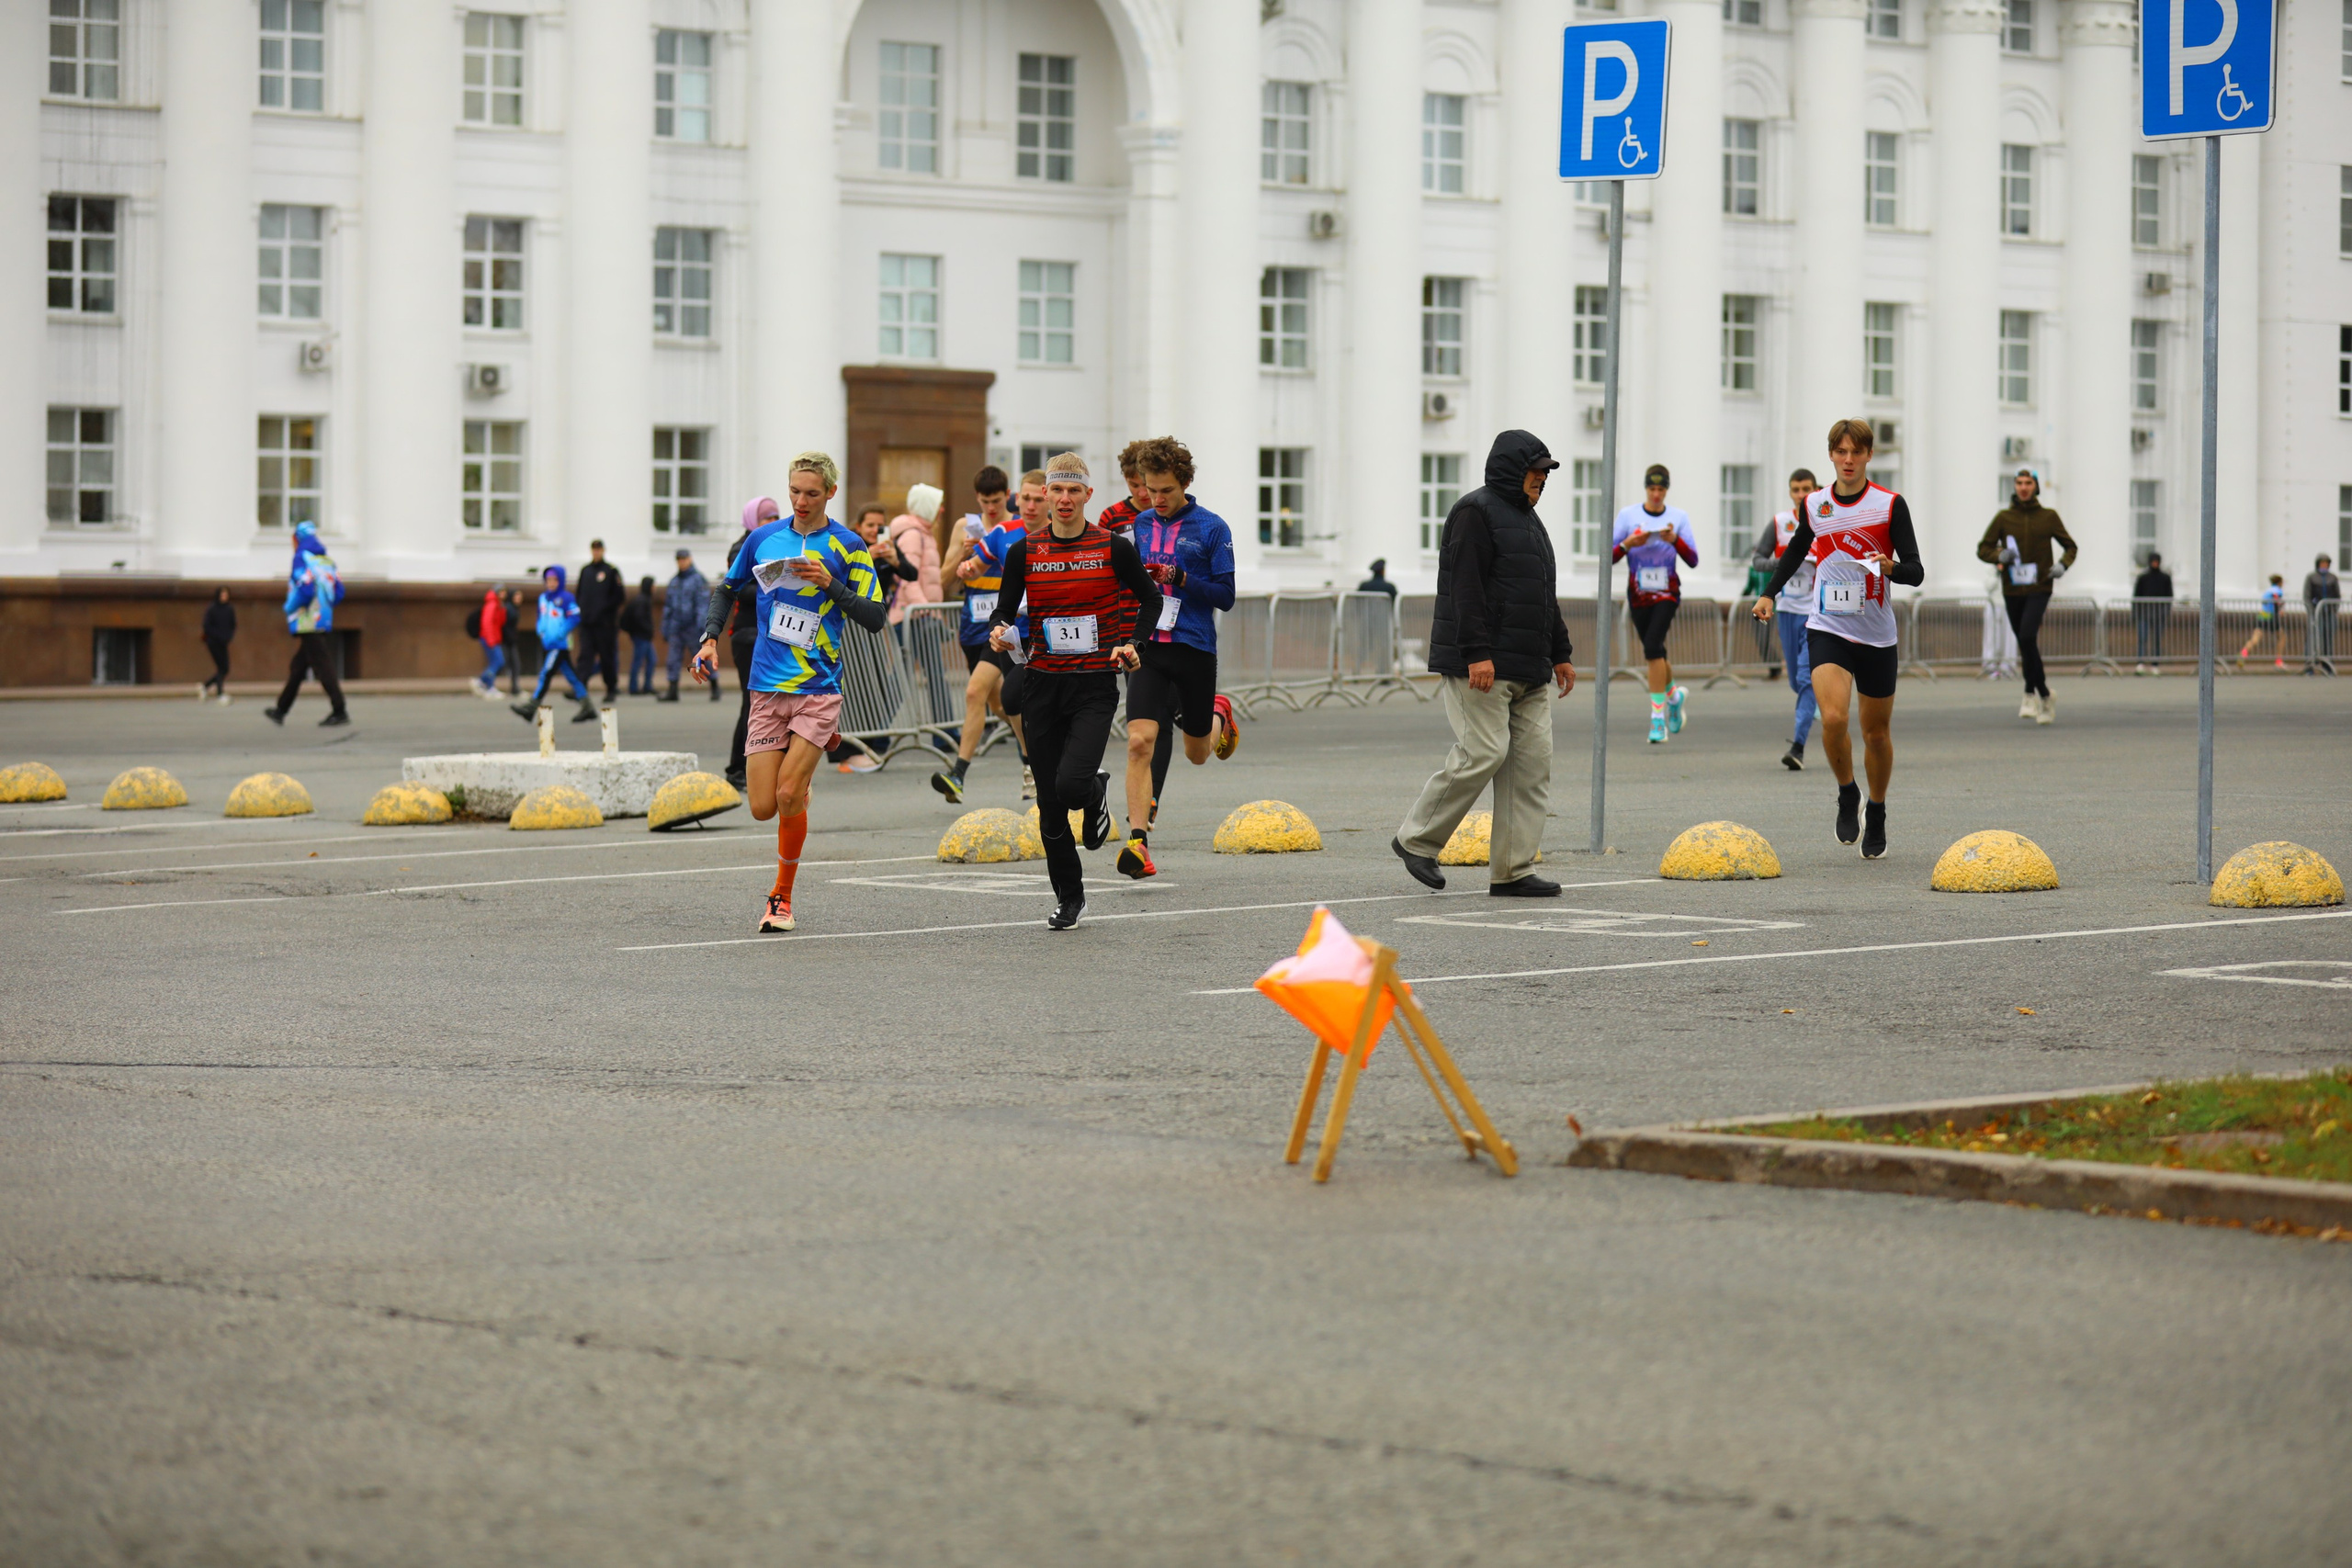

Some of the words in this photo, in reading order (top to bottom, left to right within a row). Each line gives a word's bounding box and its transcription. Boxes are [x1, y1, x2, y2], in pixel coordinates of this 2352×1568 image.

[2169, 0, 2239, 116] P
[1580, 39, 1639, 161] P
[1842, 534, 1863, 551] Run
[1032, 561, 1065, 572] NORD
[1069, 558, 1104, 570] WEST
[1834, 590, 1849, 602] 1.1
[976, 602, 994, 611] 10.1
[779, 614, 805, 632] 11.1
[1059, 626, 1080, 640] 3.1
[749, 736, 781, 747] SPORT
